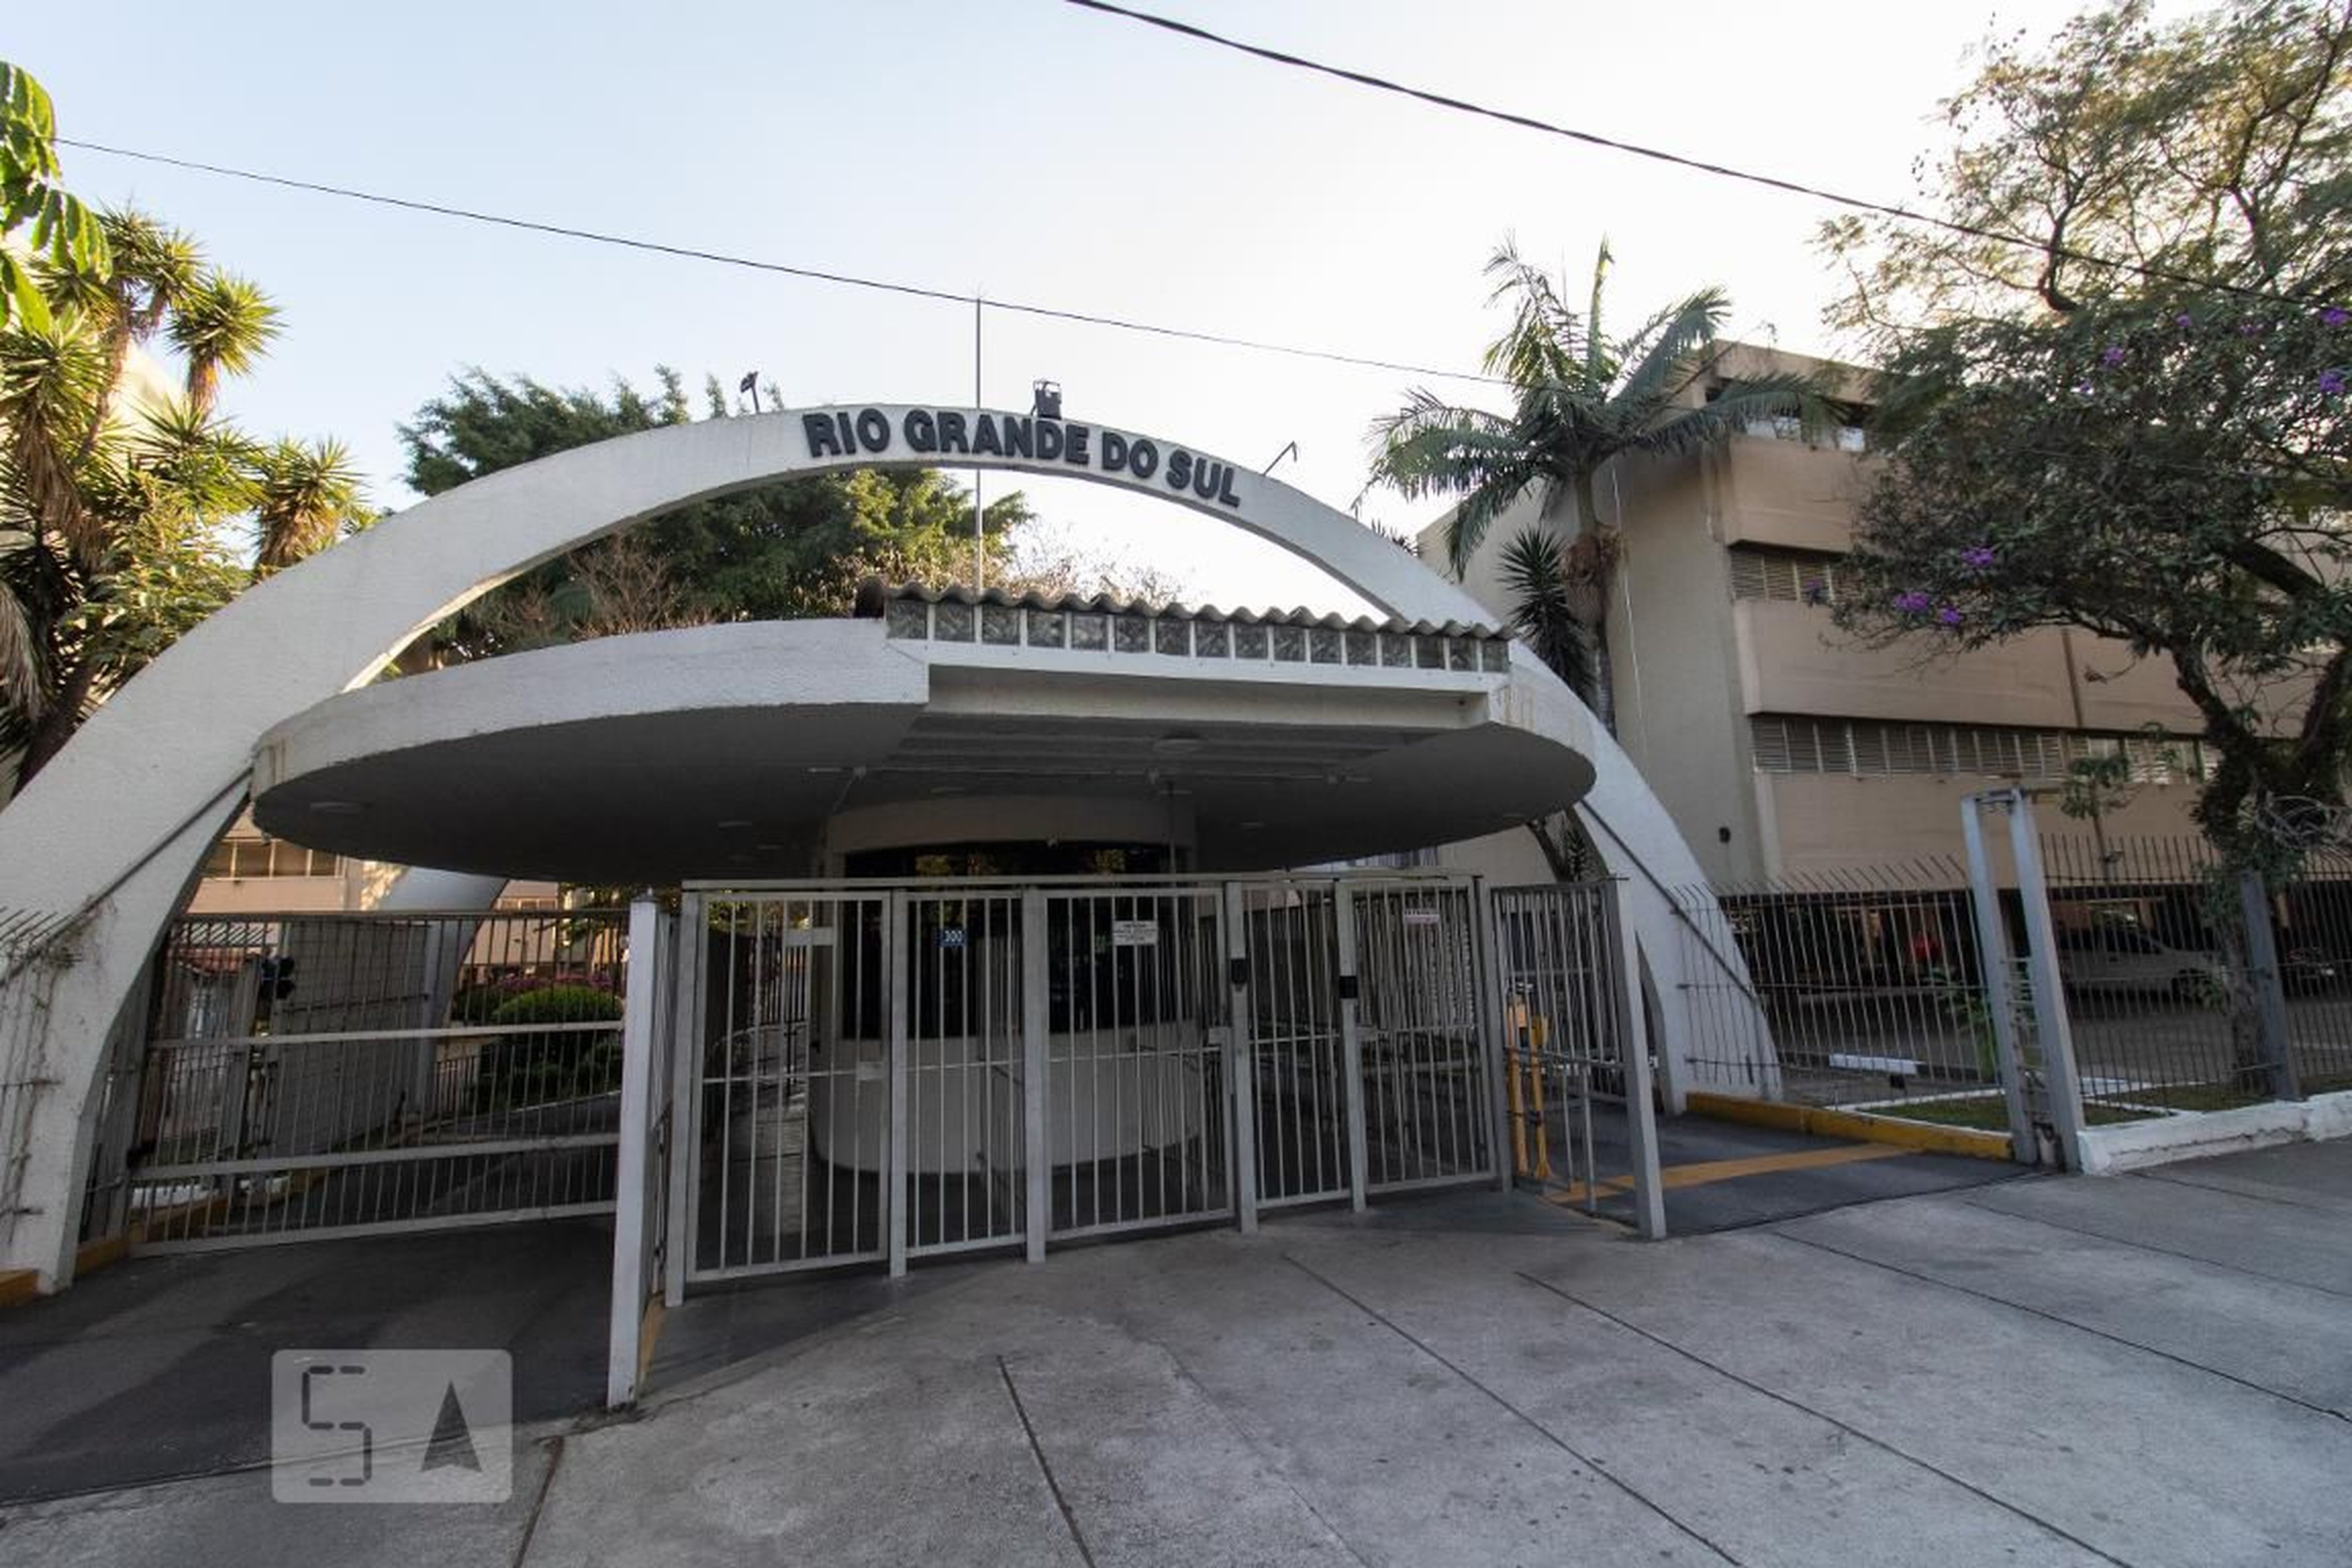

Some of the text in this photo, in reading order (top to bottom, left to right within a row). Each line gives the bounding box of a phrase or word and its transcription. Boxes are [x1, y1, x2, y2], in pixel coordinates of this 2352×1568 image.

[802, 408, 1241, 508] RIO GRANDE DO SUL
[944, 930, 962, 942] 300
